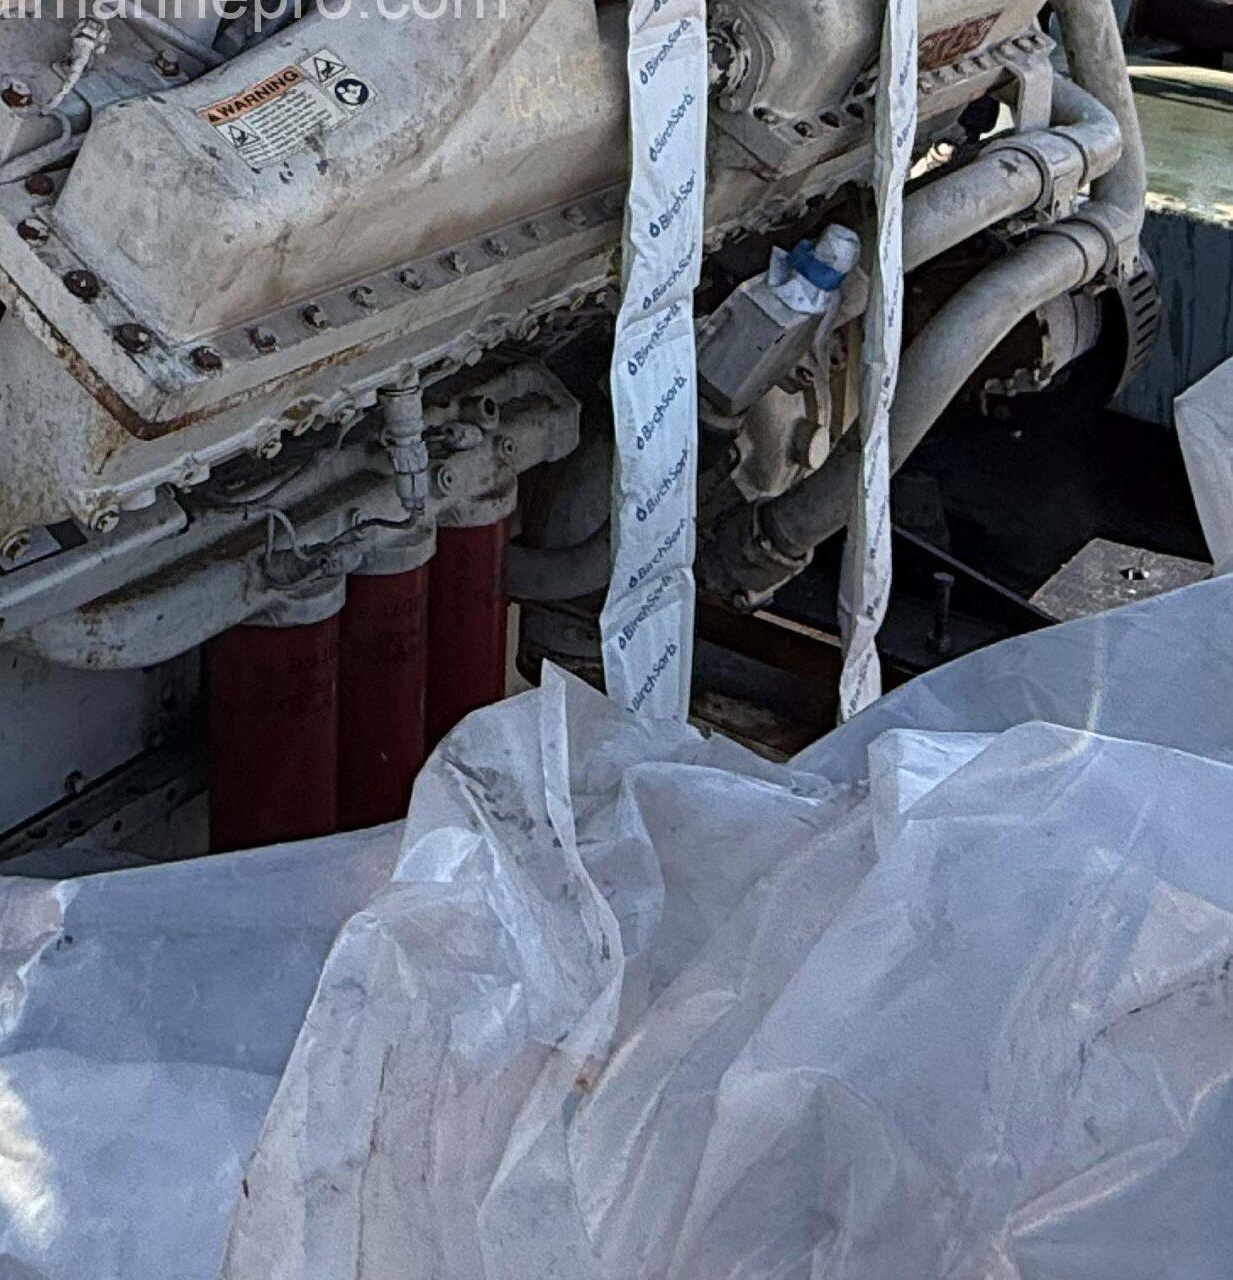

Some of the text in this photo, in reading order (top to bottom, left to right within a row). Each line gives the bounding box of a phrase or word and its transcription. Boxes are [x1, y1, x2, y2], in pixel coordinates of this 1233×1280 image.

[645, 18, 691, 78] BirchSorb
[217, 70, 299, 116] WARNING
[654, 93, 695, 152] BirchSorb
[658, 169, 697, 231] BirchSor
[641, 375, 687, 442] BirchSorb
[633, 643, 678, 711] BirchSorb
